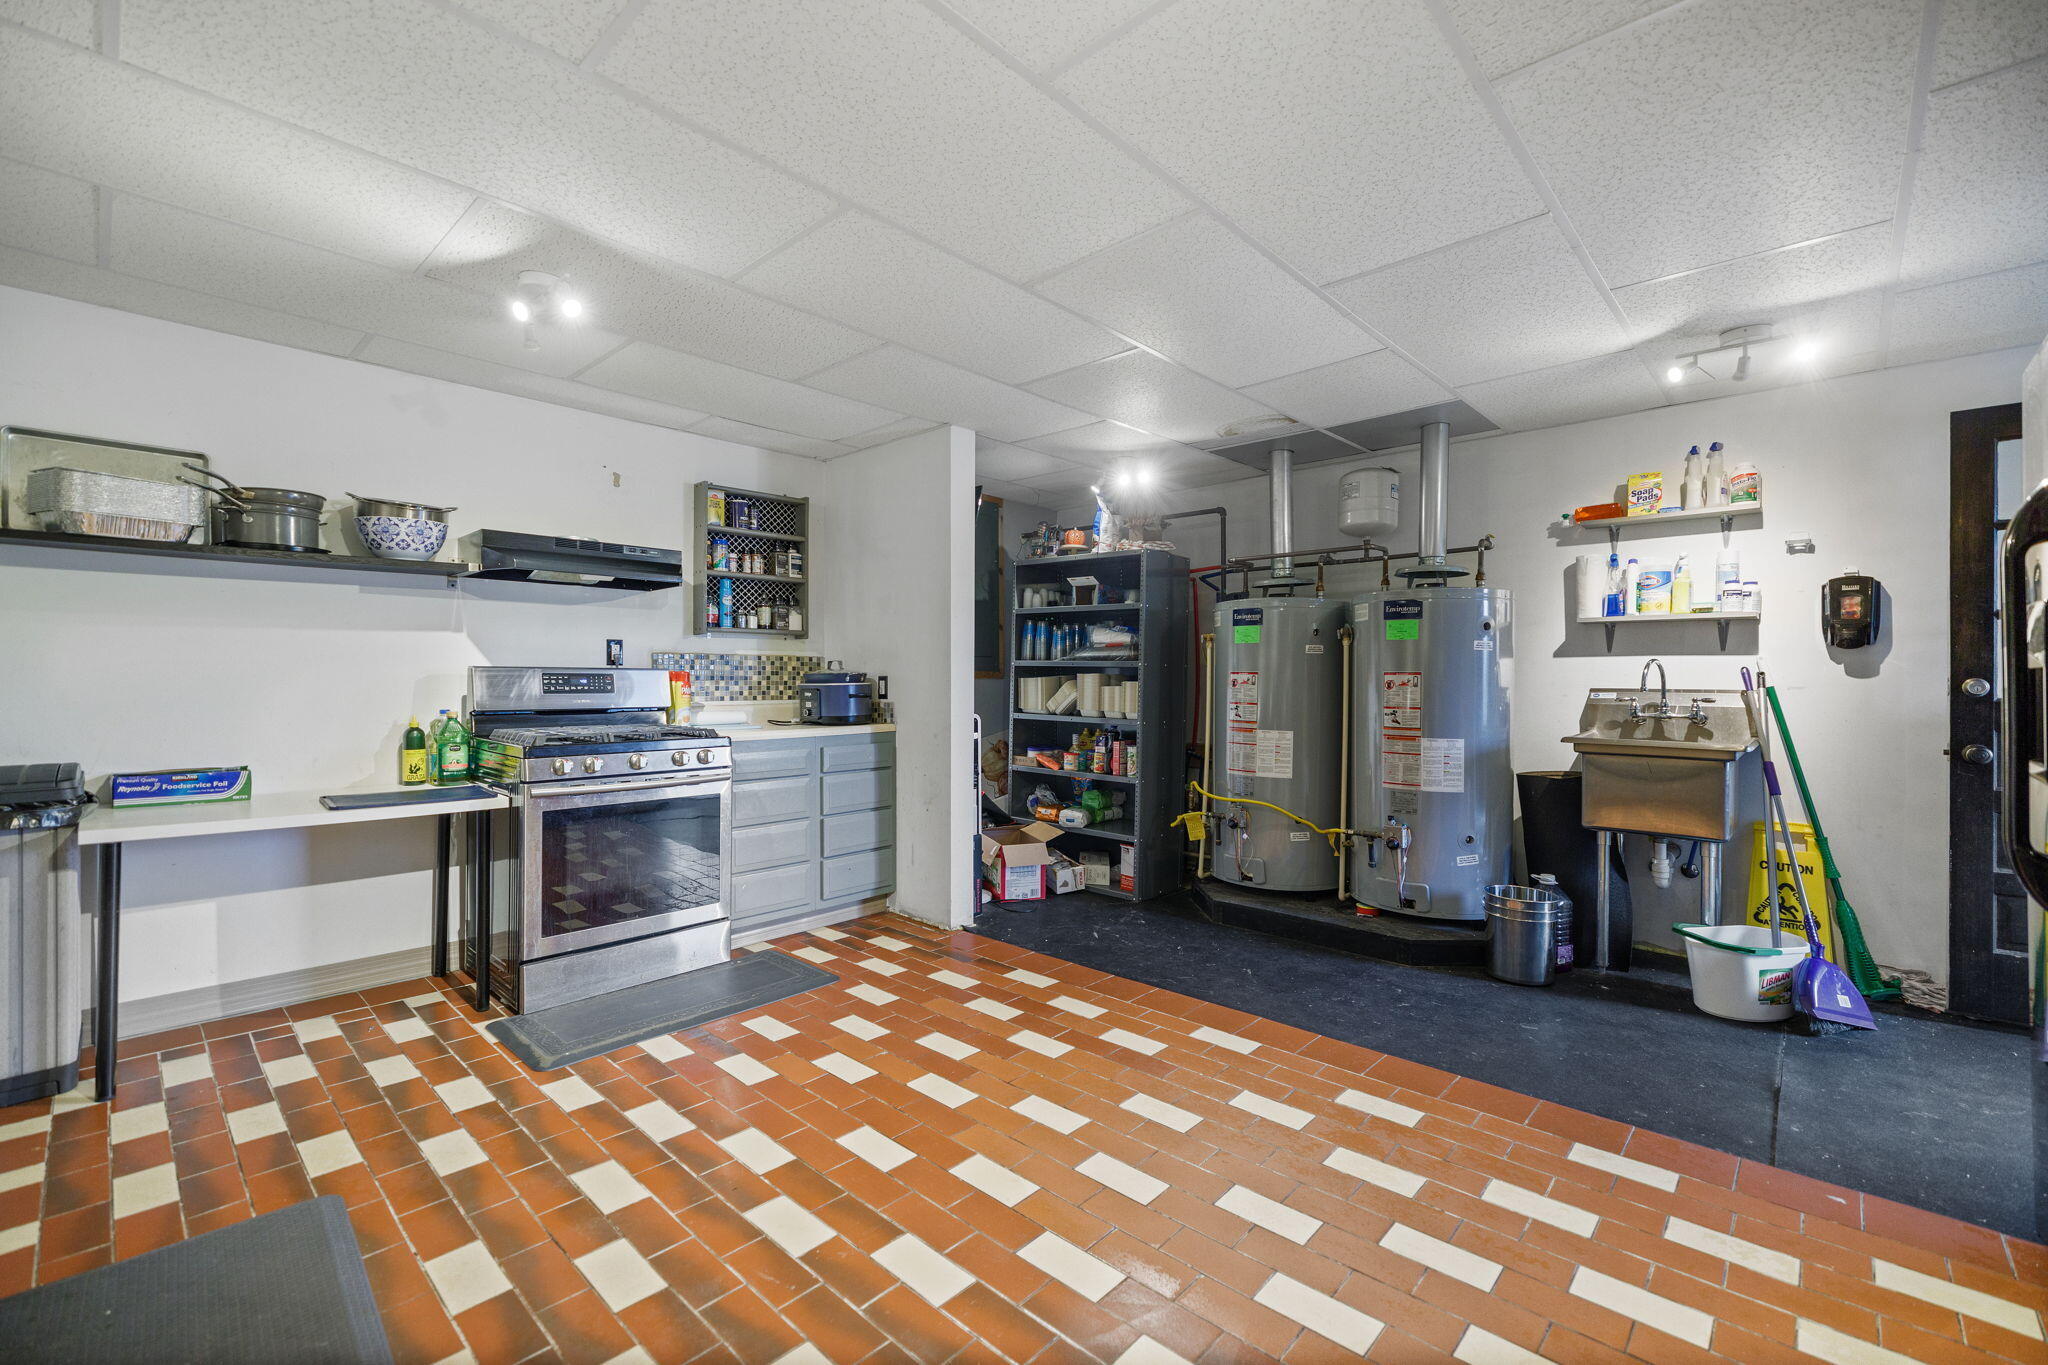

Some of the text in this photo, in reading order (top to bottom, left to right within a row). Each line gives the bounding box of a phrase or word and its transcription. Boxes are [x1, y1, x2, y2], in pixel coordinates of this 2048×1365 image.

[1631, 487, 1654, 498] Soap
[1636, 492, 1659, 503] Pads
[1385, 605, 1421, 614] Envirotemp
[117, 785, 151, 793] Reynolds
[162, 782, 212, 790] Foodservice
[1760, 860, 1813, 875] CUTON
[1761, 972, 1790, 989] LIBMAN
